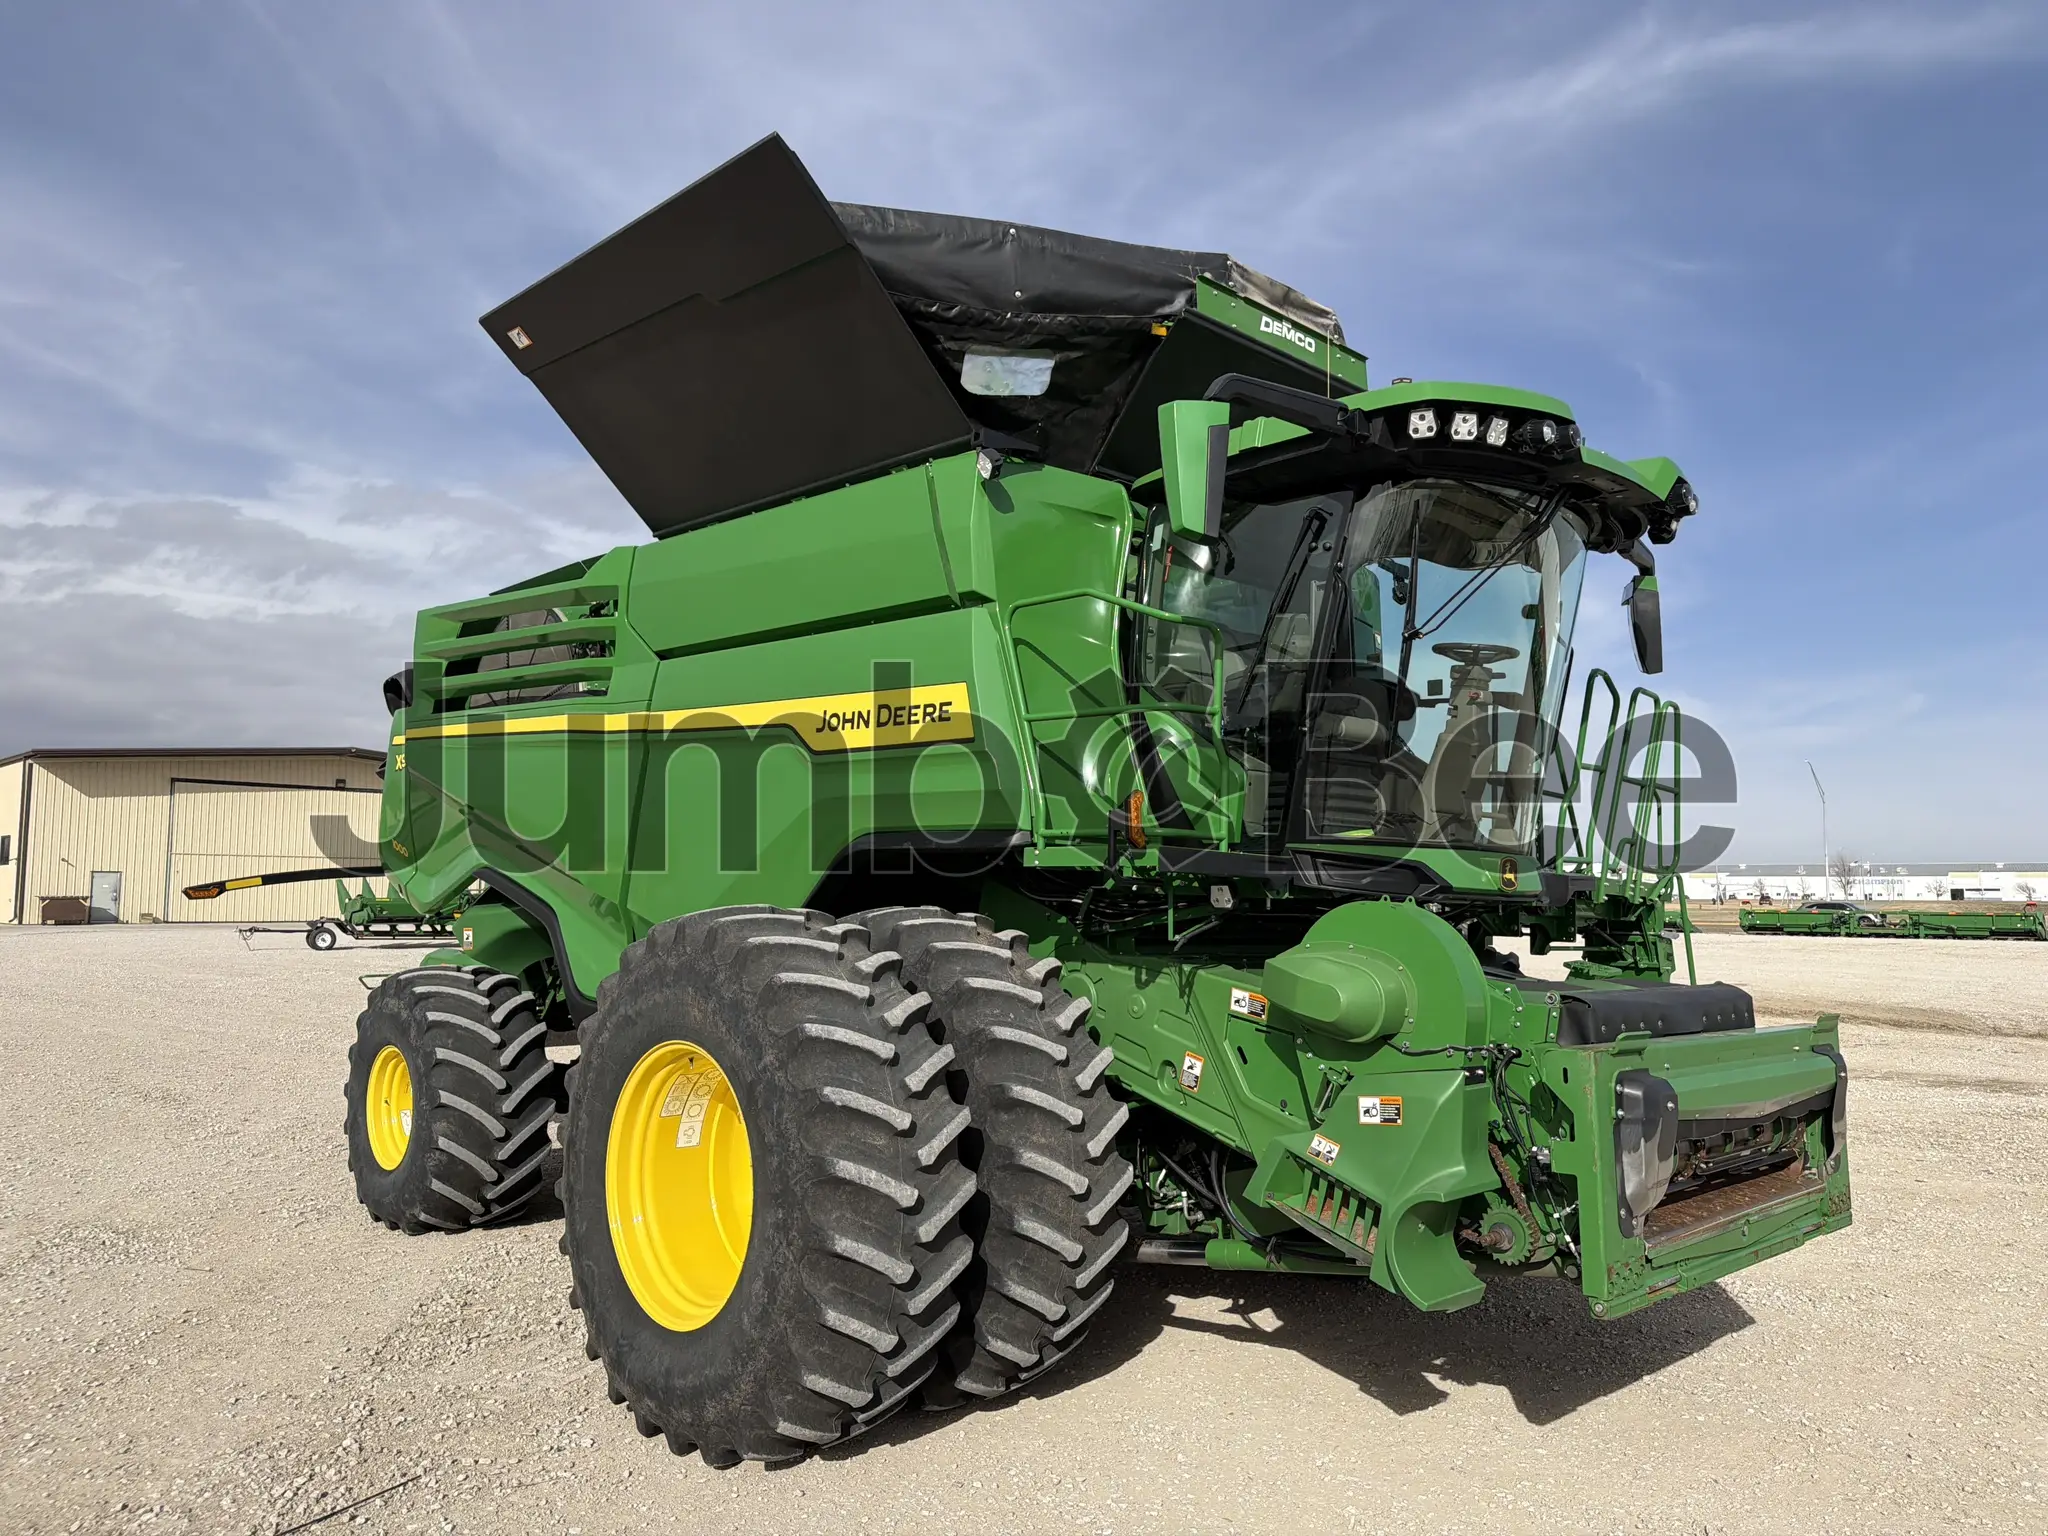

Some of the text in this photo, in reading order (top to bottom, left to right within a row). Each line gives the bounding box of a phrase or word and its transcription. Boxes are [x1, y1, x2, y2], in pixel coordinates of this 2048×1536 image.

[1260, 315, 1316, 353] DEMCO
[815, 701, 953, 733] JOHN DEERE
